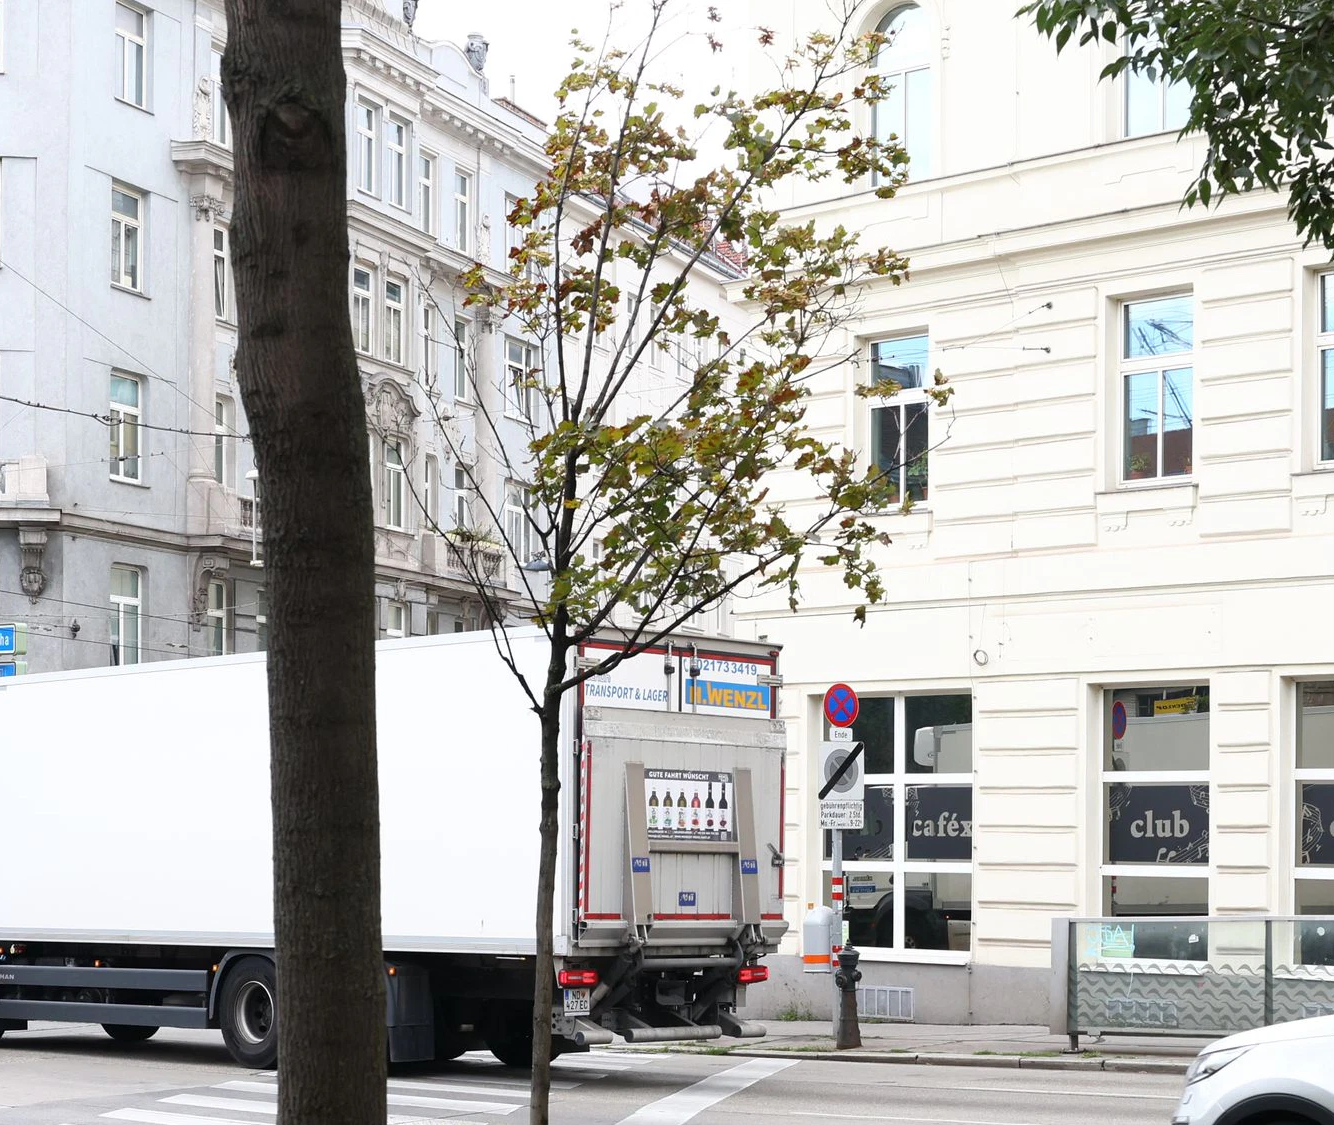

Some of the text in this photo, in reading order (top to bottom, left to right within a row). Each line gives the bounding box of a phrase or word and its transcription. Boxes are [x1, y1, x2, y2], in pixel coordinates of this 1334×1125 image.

[585, 683, 668, 702] TRANSPORT & LAGER
[834, 730, 848, 739] Ende
[683, 772, 709, 780] WÜNSCHT
[820, 802, 863, 811] gebührenpflichtig
[912, 811, 973, 837] caféx
[1130, 809, 1190, 838] club
[572, 990, 580, 1000] ND
